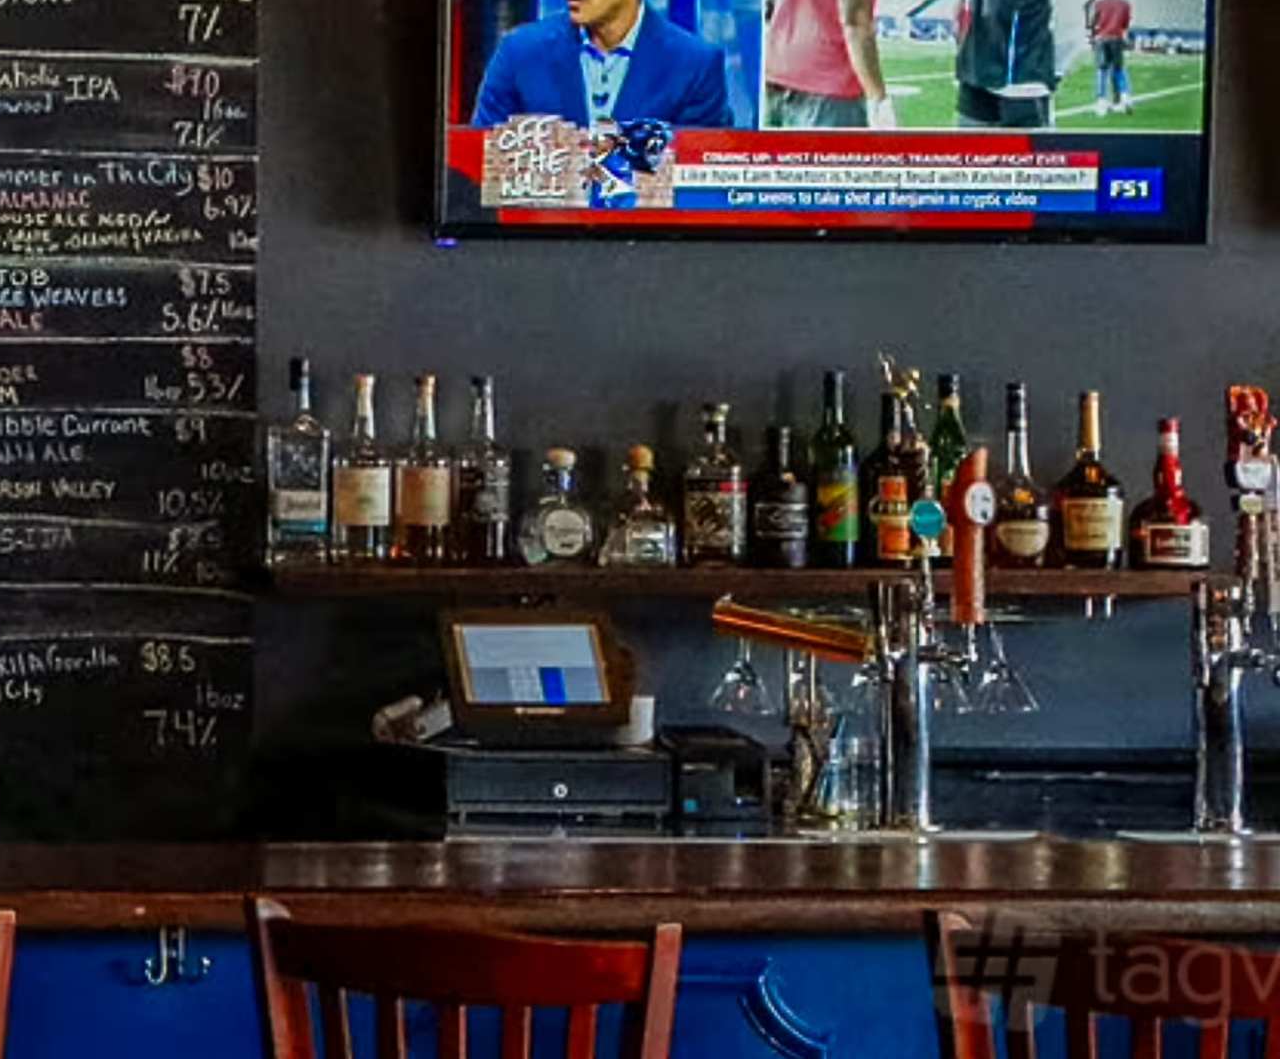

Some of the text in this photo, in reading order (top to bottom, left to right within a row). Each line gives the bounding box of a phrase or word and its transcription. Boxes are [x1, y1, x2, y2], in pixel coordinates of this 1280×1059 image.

[64, 75, 121, 103] IPA
[514, 147, 571, 175] THE
[712, 170, 739, 182] how
[938, 171, 969, 184] with
[729, 190, 754, 204] Cam
[758, 192, 796, 205] seems
[798, 191, 812, 205] to
[814, 191, 841, 205] take
[1005, 192, 1038, 206] video
[1109, 179, 1149, 198] FS1
